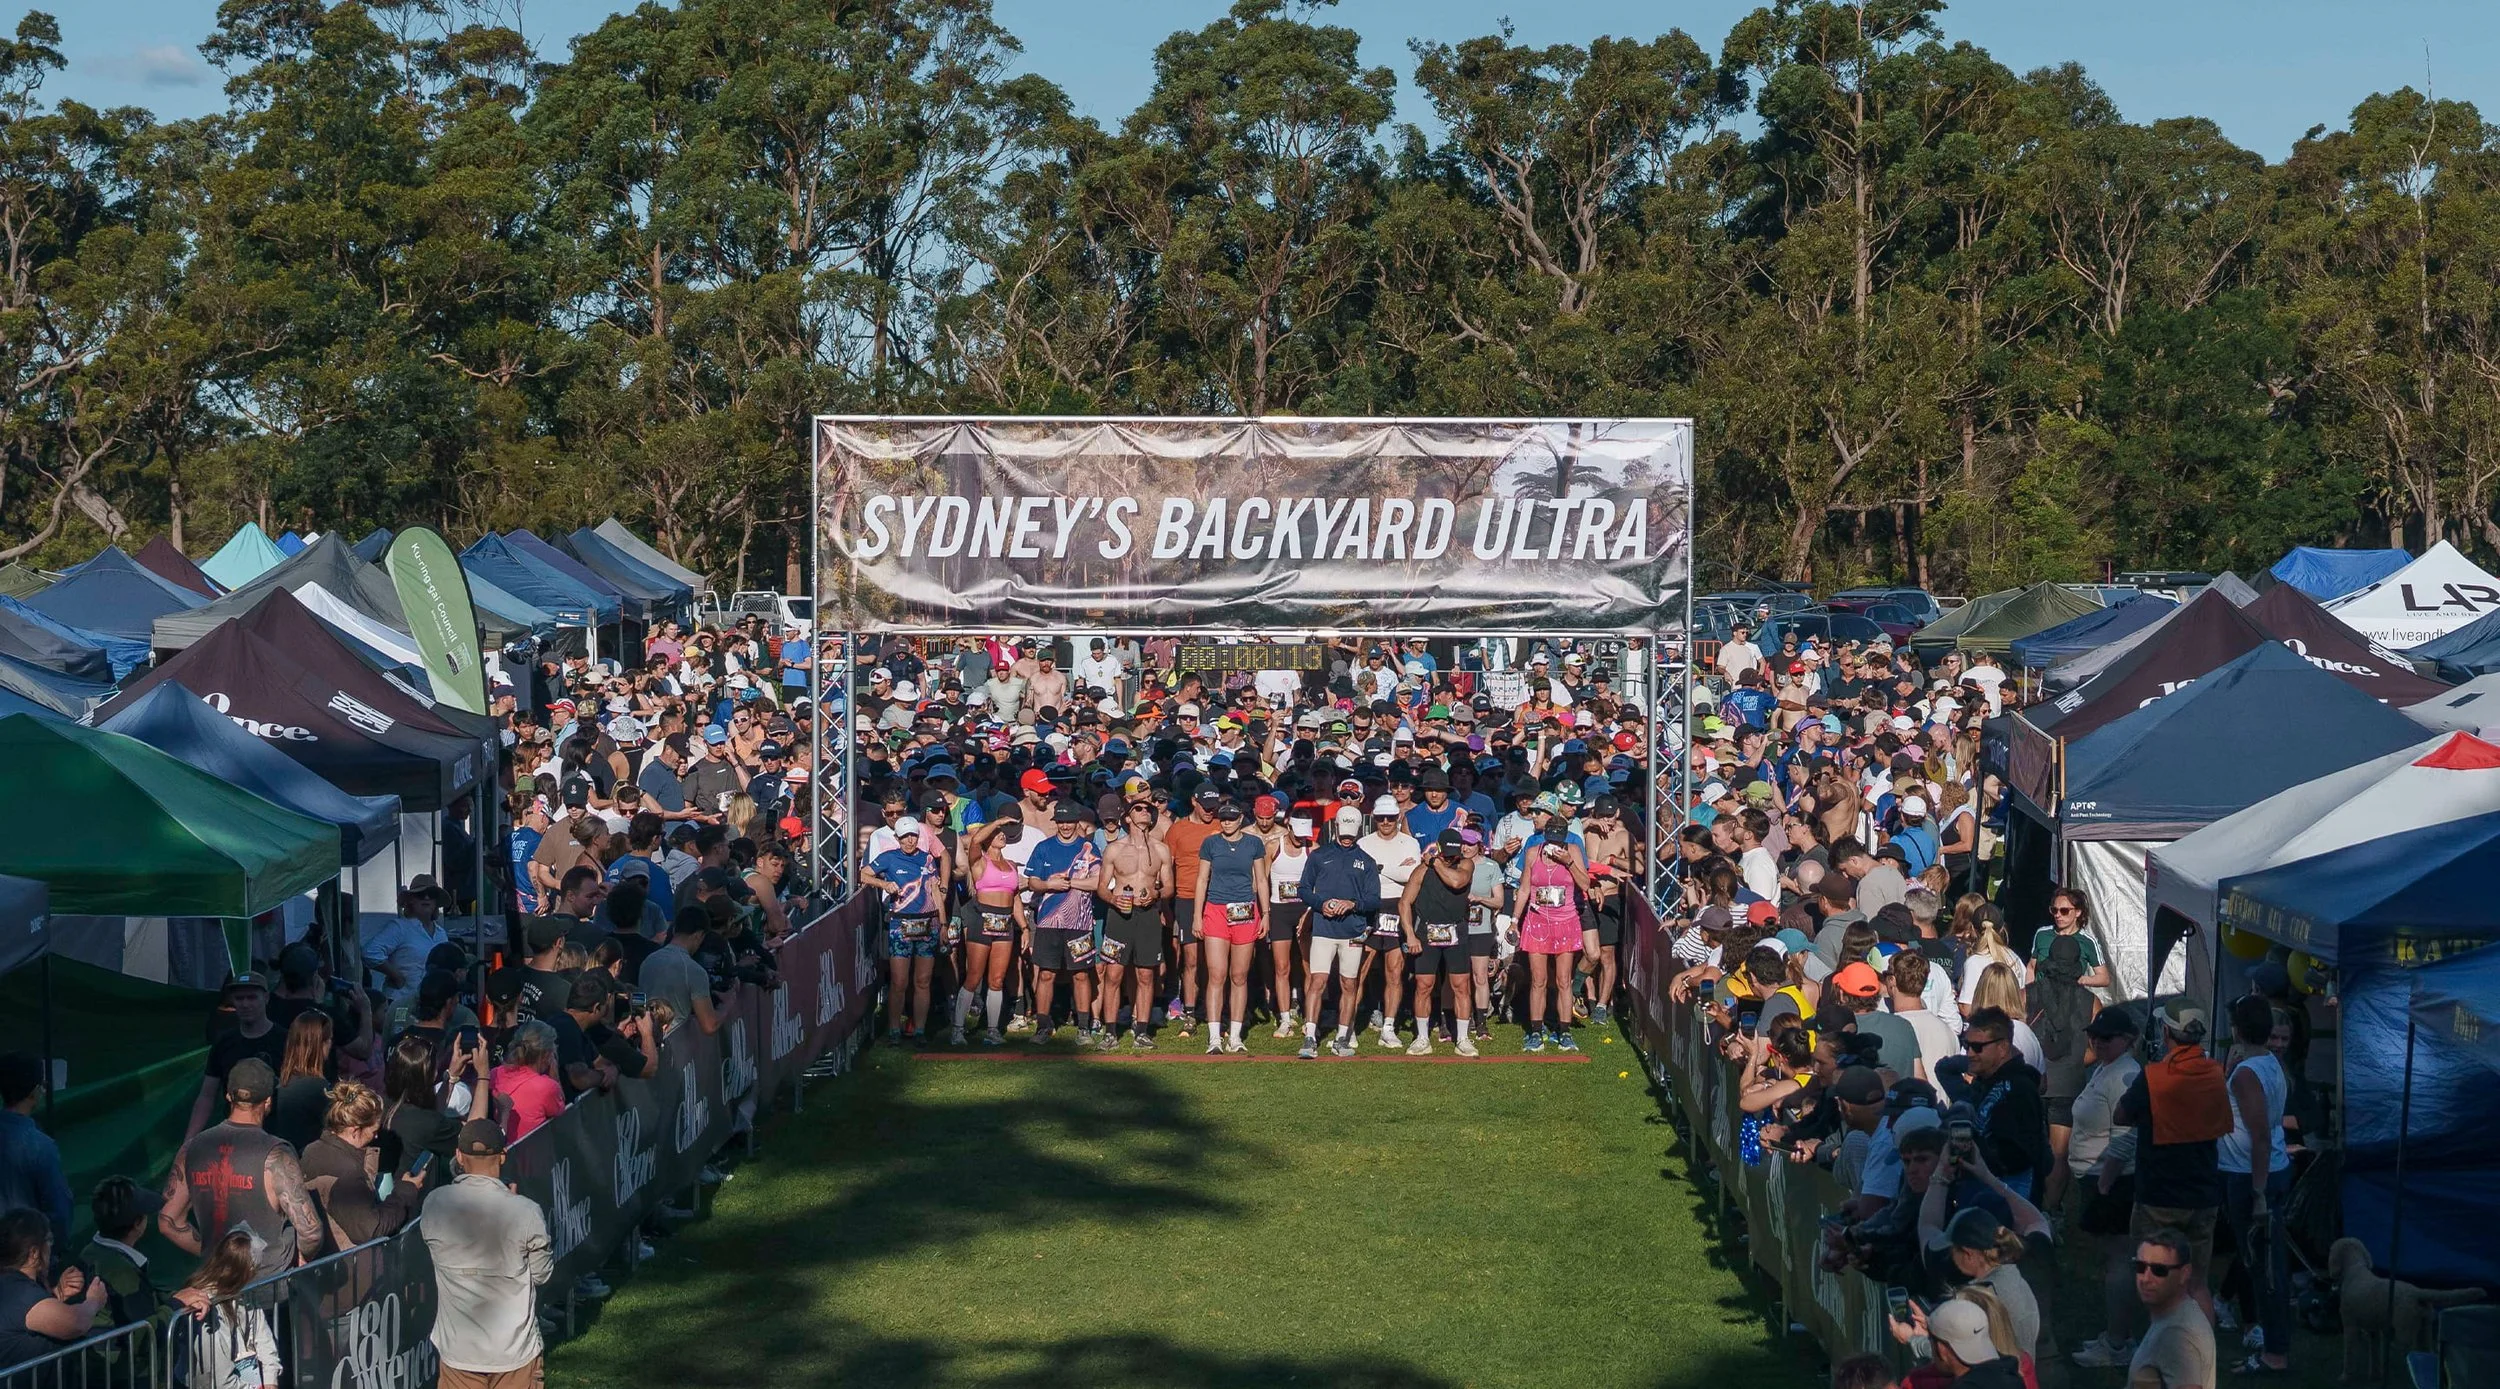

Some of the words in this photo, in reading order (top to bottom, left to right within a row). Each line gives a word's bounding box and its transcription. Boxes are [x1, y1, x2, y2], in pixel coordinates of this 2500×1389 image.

[856, 494, 1138, 559] SYDNEY'S
[1152, 496, 1455, 560] BACKYARD
[1473, 498, 1648, 560] ULTRA
[411, 543, 441, 603] Ku-ring-gai
[437, 602, 458, 643] Council
[345, 1293, 400, 1372] 180
